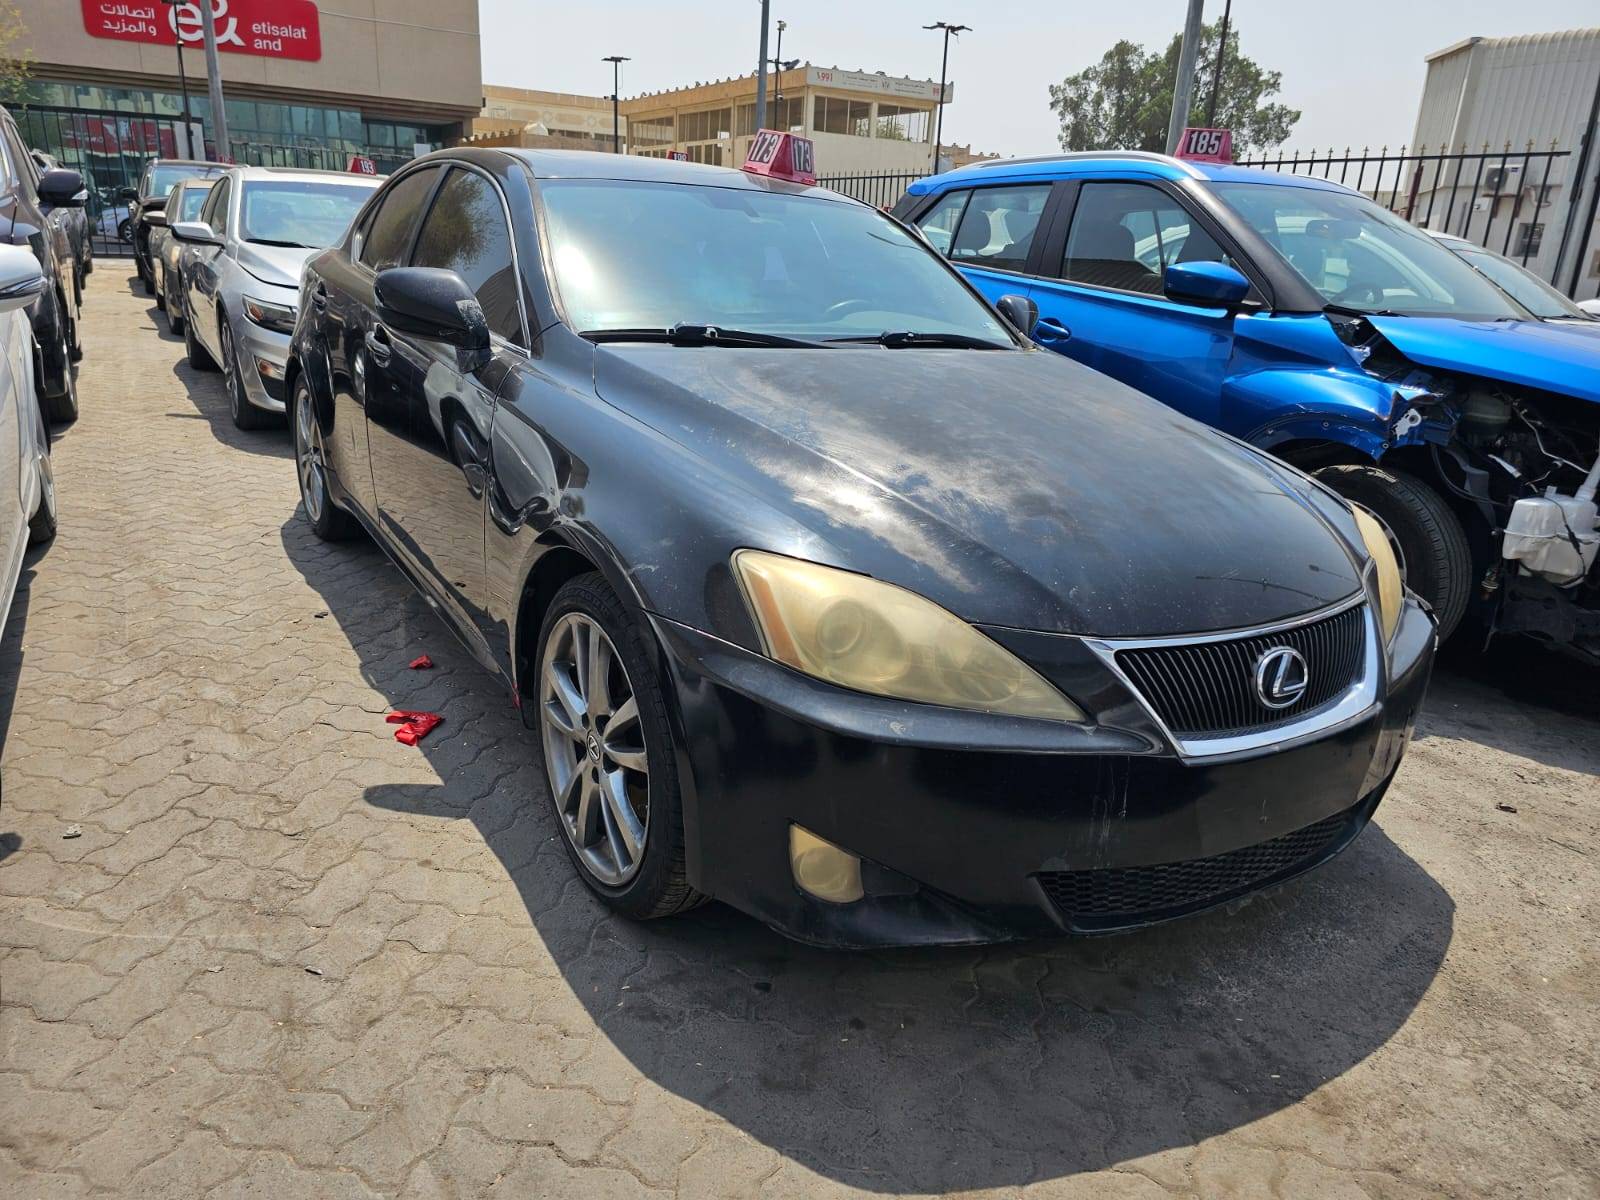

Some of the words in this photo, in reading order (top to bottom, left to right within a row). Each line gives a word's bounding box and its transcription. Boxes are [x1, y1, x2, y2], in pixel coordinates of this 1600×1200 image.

[100, 3, 155, 19] اتصالات
[103, 19, 146, 33] المزيد
[148, 25, 157, 36] و
[252, 22, 307, 39] etisalat
[254, 38, 282, 51] and
[750, 133, 779, 162] 173
[1189, 131, 1221, 154] 185
[793, 140, 811, 172] 173
[360, 160, 375, 174] 193
